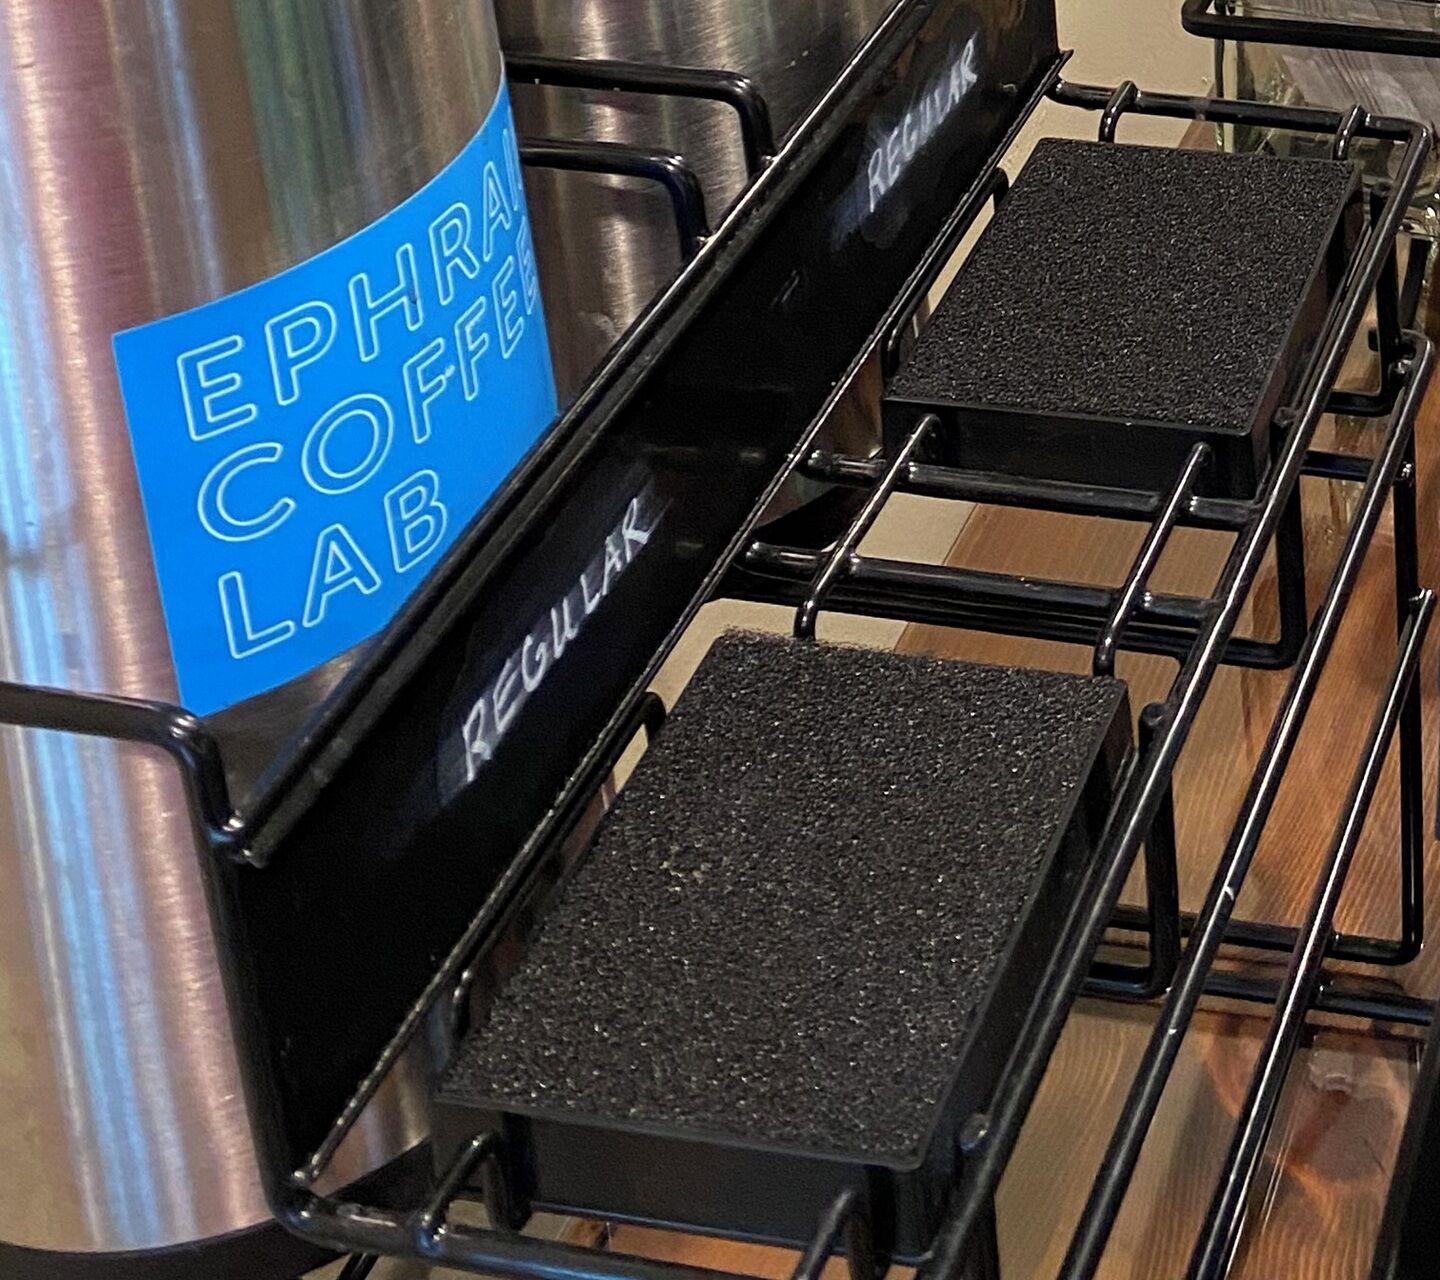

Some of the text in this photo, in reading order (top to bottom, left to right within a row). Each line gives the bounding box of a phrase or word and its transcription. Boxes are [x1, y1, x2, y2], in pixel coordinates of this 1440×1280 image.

[865, 36, 980, 214] REGULAR
[176, 104, 523, 444] EPHRAI
[196, 214, 539, 543] COFFEE
[217, 468, 448, 661] LAB
[459, 496, 653, 787] REGULAR
